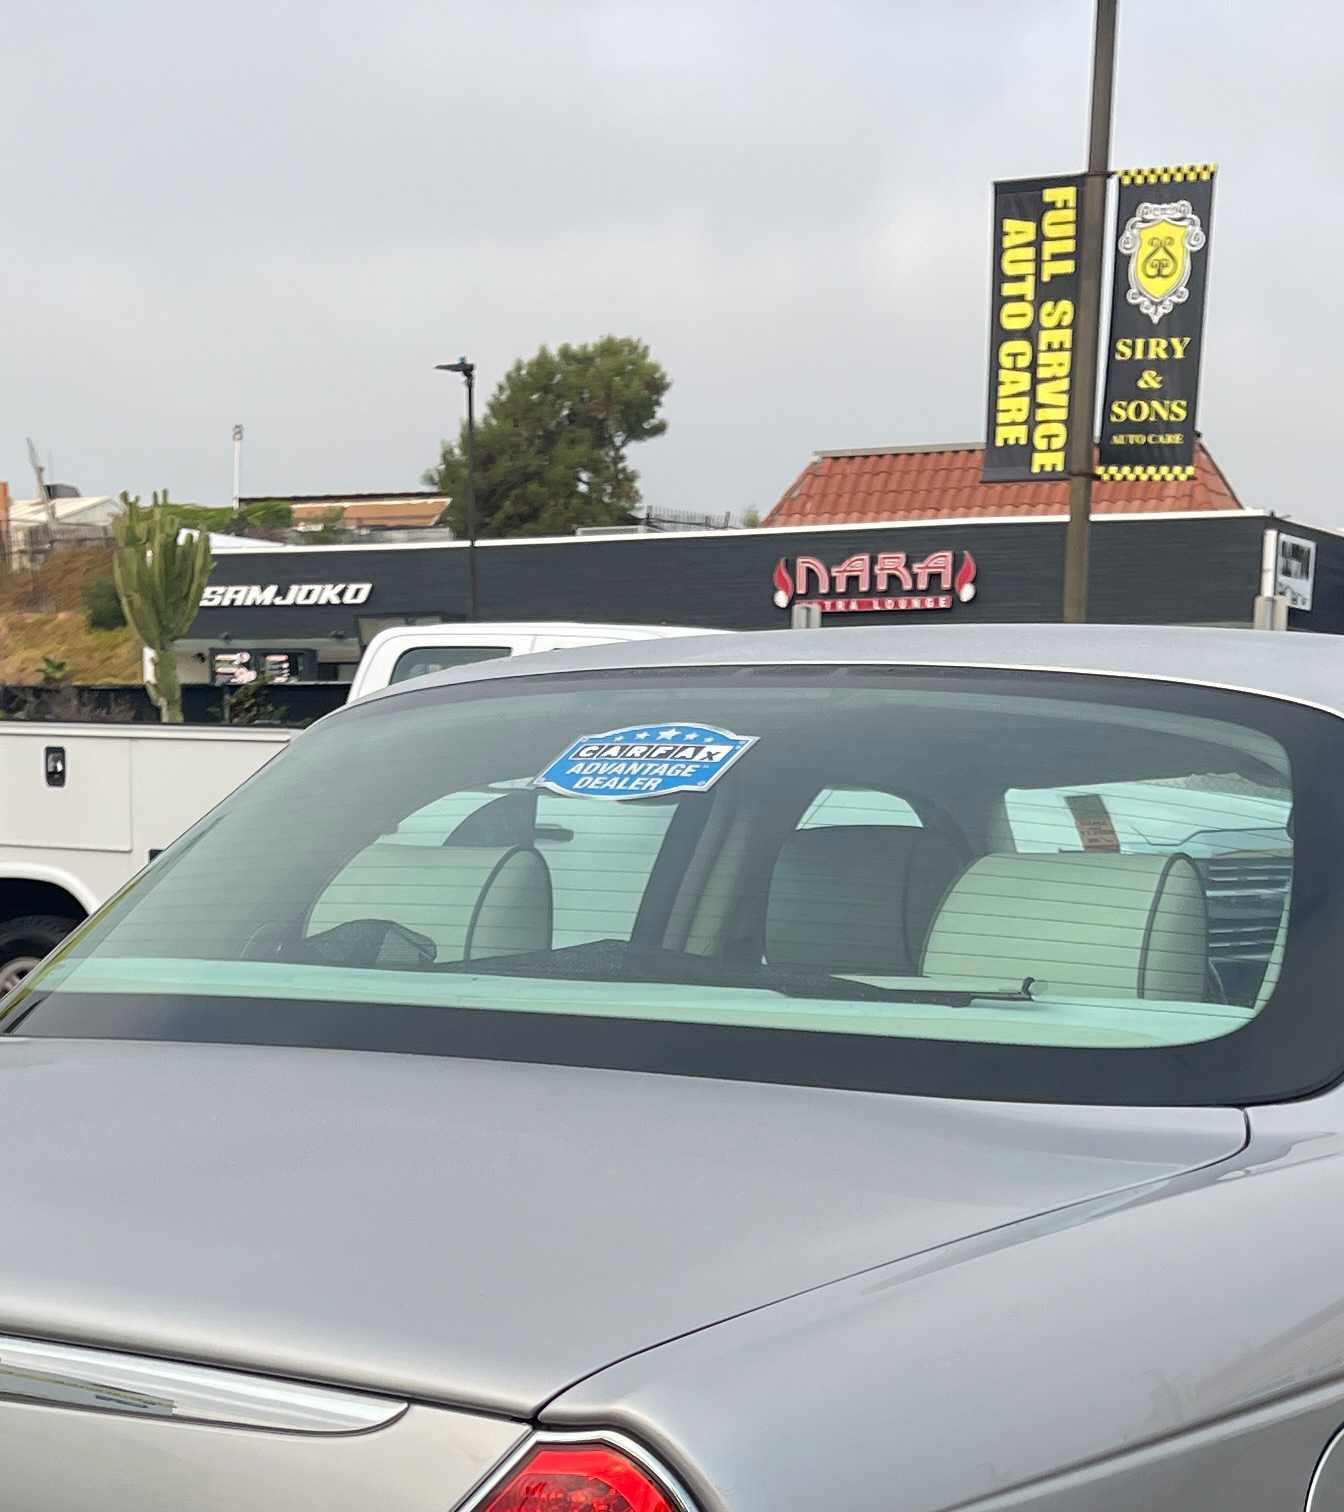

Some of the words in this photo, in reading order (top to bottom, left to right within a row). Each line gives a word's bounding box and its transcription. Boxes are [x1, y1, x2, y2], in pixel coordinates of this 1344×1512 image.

[1041, 186, 1077, 283] FULL
[999, 218, 1037, 330] AUTO
[1115, 337, 1191, 360] SIRY
[1030, 299, 1075, 474] SERVICE
[1137, 369, 1163, 389] &
[995, 340, 1033, 447] CARE
[1110, 400, 1187, 422] SONS
[1110, 434, 1146, 445] AUTO
[796, 550, 953, 594] NARA
[199, 583, 372, 607] SAMJOKO
[871, 598, 947, 610] LOUNGE
[573, 744, 726, 762] CARFAX
[566, 763, 700, 778] ADVANTAGE
[572, 777, 663, 791] DEALER
